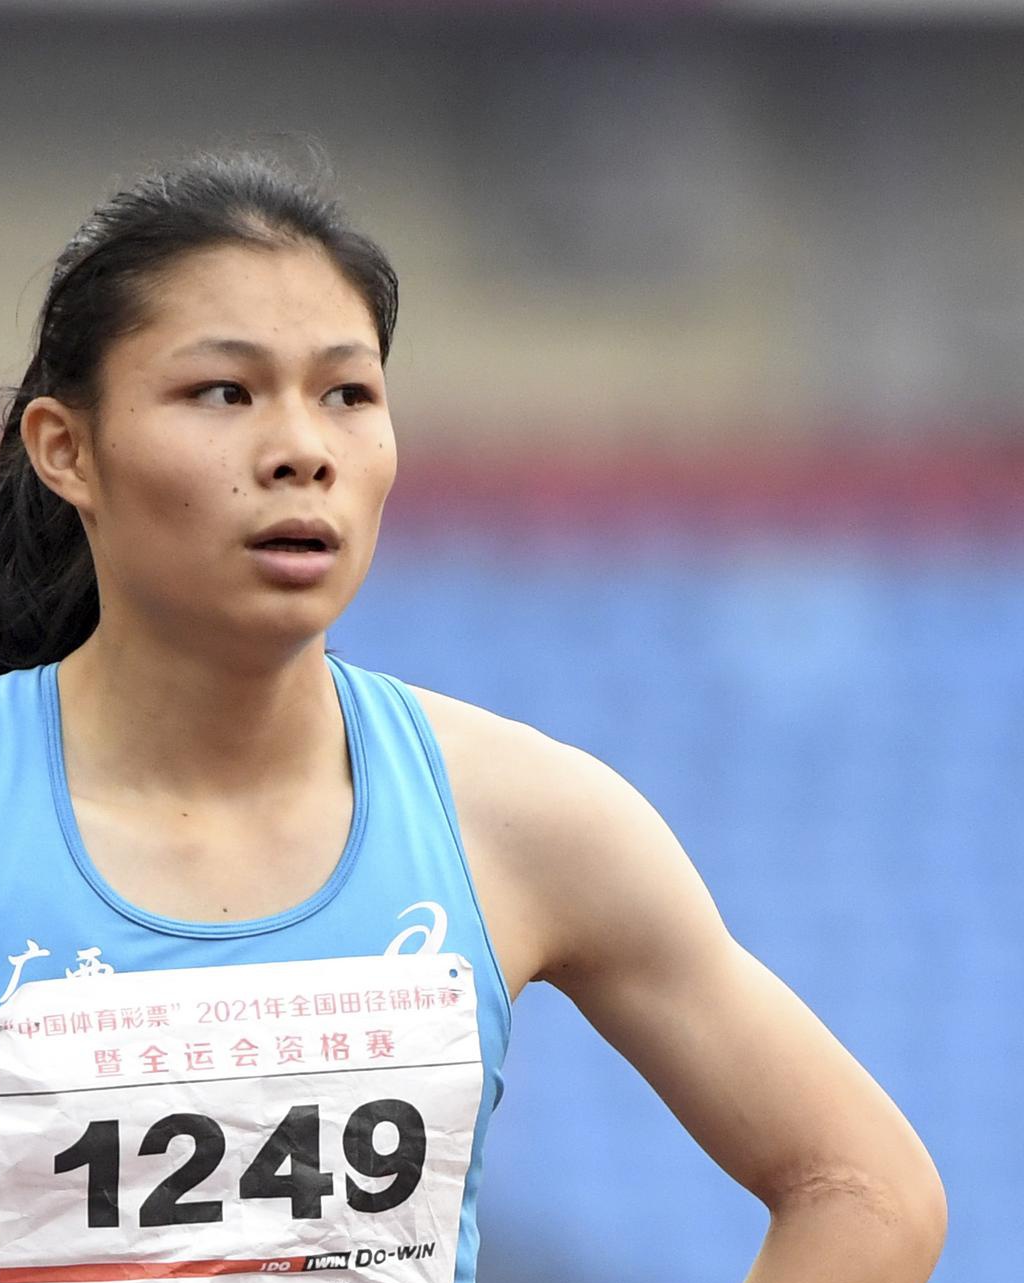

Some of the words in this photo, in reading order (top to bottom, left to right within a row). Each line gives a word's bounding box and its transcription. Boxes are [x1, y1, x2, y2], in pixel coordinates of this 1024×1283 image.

[93, 1029, 396, 1079] 暨全运会资格赛
[53, 1098, 427, 1229] 1249
[267, 1260, 291, 1272] DO
[314, 1255, 347, 1269] WIN
